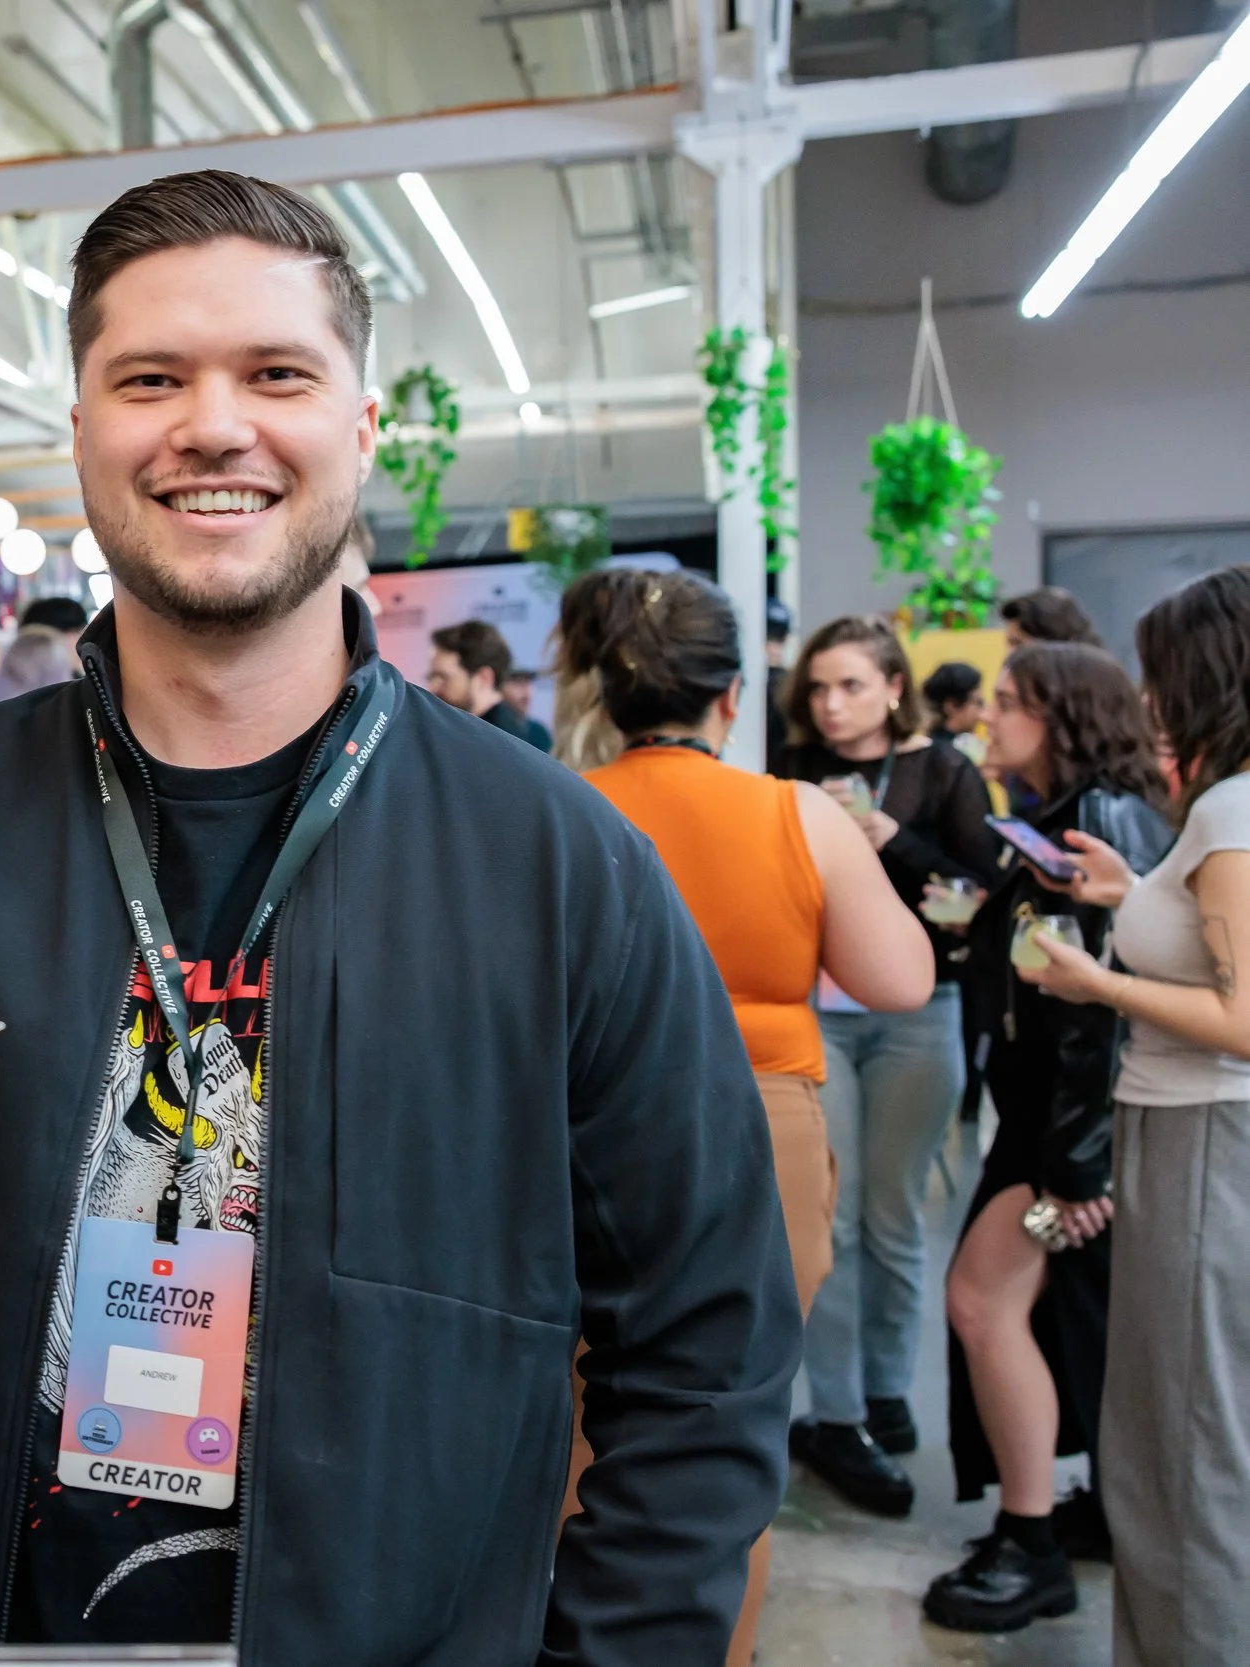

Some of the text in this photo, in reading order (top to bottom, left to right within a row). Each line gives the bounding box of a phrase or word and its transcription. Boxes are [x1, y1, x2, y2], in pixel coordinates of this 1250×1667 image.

[94, 748, 111, 804] COLLECTIVE
[329, 711, 388, 808] CREATOR COLLECTIVE
[131, 900, 179, 1014] CREATOR COLLECTIVE
[107, 1280, 215, 1311] CREATOR
[105, 1302, 213, 1329] COLLECTIVE
[140, 1369, 178, 1381] ANDREW
[88, 1461, 202, 1496] CREATOR
